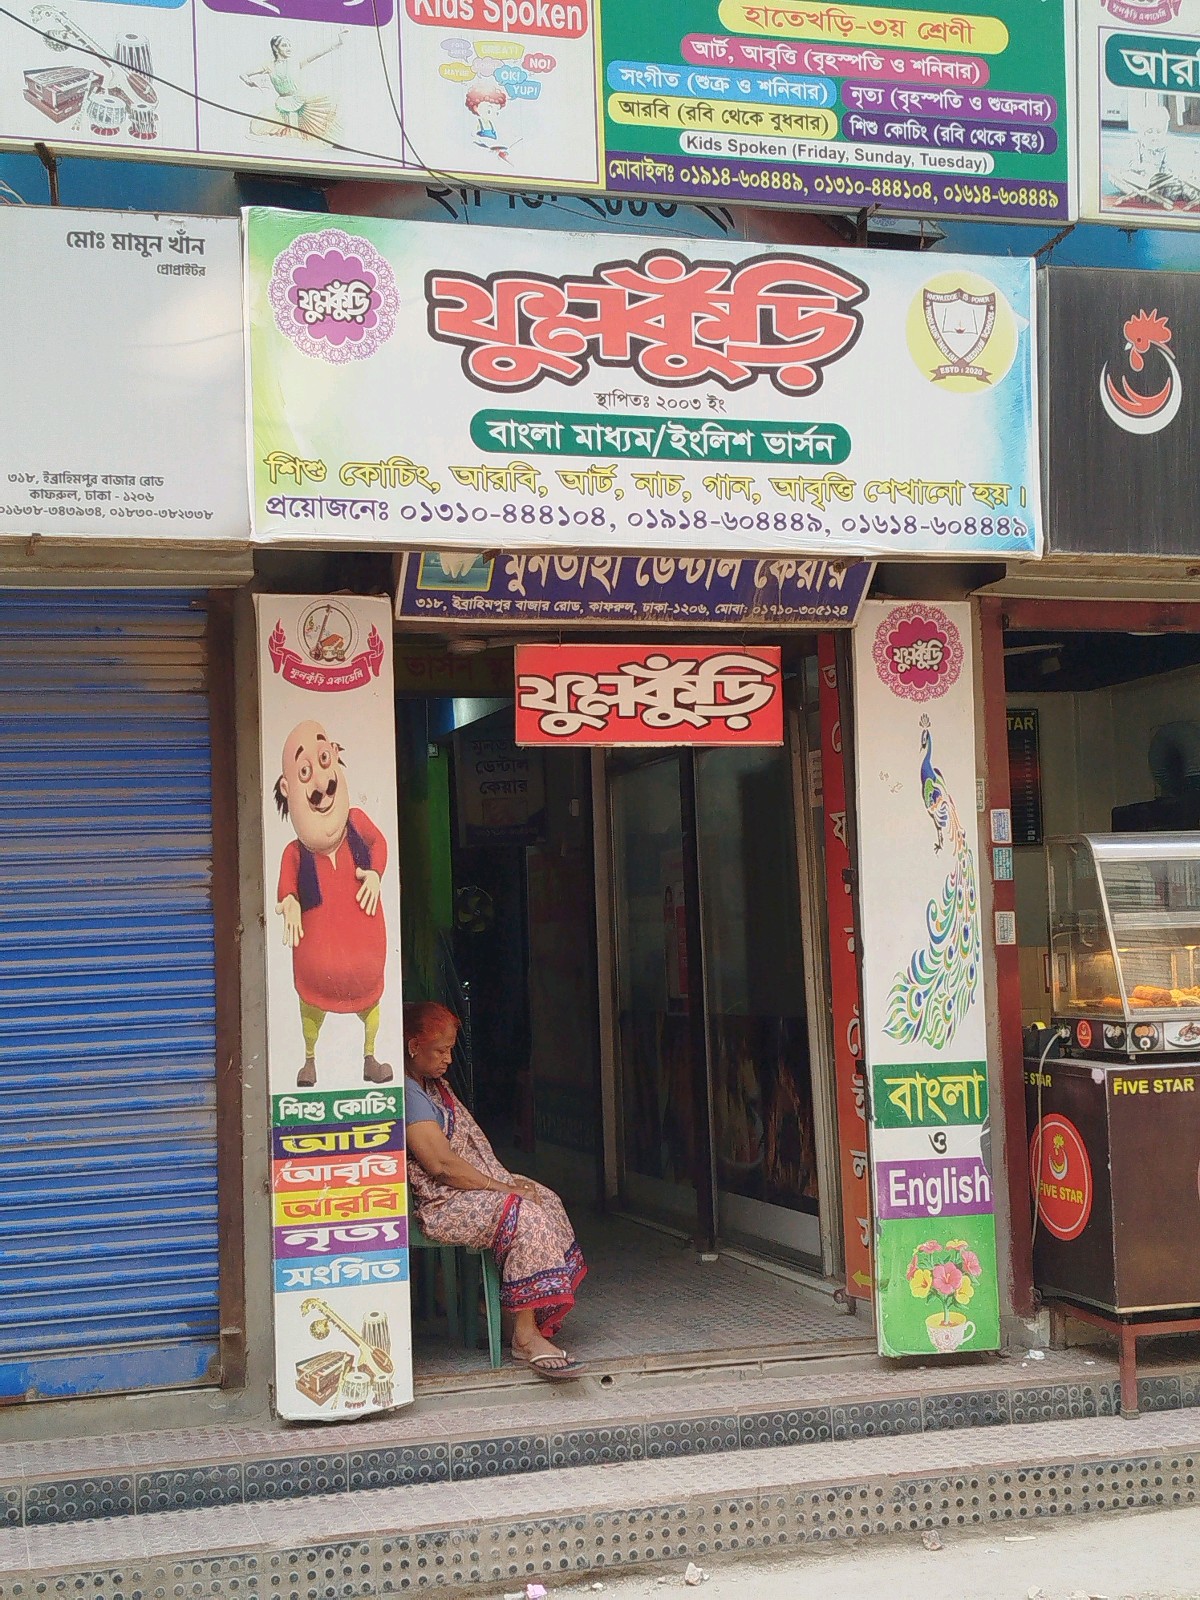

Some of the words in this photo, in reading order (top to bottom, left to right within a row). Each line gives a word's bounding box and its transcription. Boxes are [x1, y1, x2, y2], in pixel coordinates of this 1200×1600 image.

[483, 0, 583, 32] Spoken
[742, 5, 907, 38] হাতেখড়ি-৩য়
[918, 18, 976, 44] শ্রেণী
[501, 70, 519, 81] OK!
[529, 58, 550, 70] NO!
[690, 38, 735, 63] আর্ট,
[739, 43, 797, 69] আবৃত্তি
[804, 50, 885, 74] (বৃহস্পতি
[890, 58, 905, 73] ও
[911, 56, 981, 84] শনিবার)
[1119, 48, 1200, 88] আর
[513, 85, 538, 95] YUP!
[619, 65, 680, 89] সংগীত
[687, 72, 730, 95] (শুক্র
[736, 79, 751, 93] ও
[757, 76, 828, 105] শনিবার)
[618, 98, 671, 120] আরবি
[678, 101, 715, 125] (রবি
[721, 108, 764, 125] থেকে
[770, 112, 829, 135] বুধবার)
[850, 86, 885, 110] নৃত্য
[891, 87, 963, 113] (বৃহস্পতি
[969, 97, 983, 111] ও
[988, 96, 1052, 120] শুক্রবার)
[849, 115, 878, 136] শিশু
[884, 119, 929, 142] কোচিং
[934, 122, 965, 146] (রবি
[971, 128, 1007, 146] থেকে
[1010, 130, 1045, 154] বৃহঃ)
[686, 135, 722, 151] Kids
[728, 138, 787, 157] Spoken
[793, 143, 849, 163] (Friday,
[854, 148, 915, 168] Sunday,
[920, 152, 988, 173] Tuesday)
[608, 156, 675, 184] মোবাইলঃ
[680, 165, 809, 196] ০১৯১৪-৬০৪৪৪৯,
[814, 174, 938, 204] ০১৩১০-৪৪৪১০৪,
[944, 185, 1059, 209] ০১৬১৪-৬০৪৪৪৯
[66, 230, 105, 249] মোঃ
[111, 232, 163, 258] মামুন
[965, 367, 982, 375] 2020
[656, 395, 702, 411] ২০০৩
[706, 393, 727, 413] ইং
[486, 418, 565, 450] বাংলা
[571, 422, 755, 459] মাধ্যম/ইংলিশ
[761, 425, 837, 461] ভার্সন
[7, 473, 39, 485] ৩১৮,
[101, 474, 136, 487] বাজার
[139, 476, 165, 487] রোড
[85, 489, 111, 501] ঢাকা
[123, 491, 155, 502] ১২০৬
[263, 451, 328, 486] শিশু
[339, 455, 442, 494] কোচিং,
[448, 460, 549, 498] আরবি,
[555, 464, 625, 501] আর্ট,
[630, 471, 692, 503] নাচ,
[702, 472, 762, 505] গান,
[768, 472, 857, 512] আবৃত্তি
[864, 477, 966, 506] শেখানো
[969, 481, 1013, 510] হয়
[400, 501, 616, 533] ০১৩১০-৪৪৪১০৪,
[628, 508, 831, 538] ০১৯১৪-৬০৪৪৪৯,
[841, 514, 1028, 537] ০১৬১৪-৬০৪৪৪৯
[415, 598, 448, 612] ৩১৮,
[515, 600, 550, 612] বাজার
[553, 600, 584, 614] রোড,
[642, 602, 710, 616] ঢাকা-১২০৬,
[1006, 717, 1034, 731] TAR
[883, 1068, 986, 1123] বাংলা
[1113, 1077, 1149, 1095] FIVE
[1153, 1077, 1195, 1094] STAR
[278, 1096, 326, 1120] শিশু
[333, 1091, 397, 1120] কোচিং
[279, 1121, 397, 1153] আর্ট
[928, 1131, 947, 1154] ও
[280, 1154, 399, 1185] আবৃত্তি
[281, 1187, 399, 1218] আরবি
[889, 1166, 990, 1214] English
[1060, 1186, 1083, 1204] STAR
[281, 1221, 400, 1252] নৃত্য
[283, 1257, 401, 1287] সংগিত
